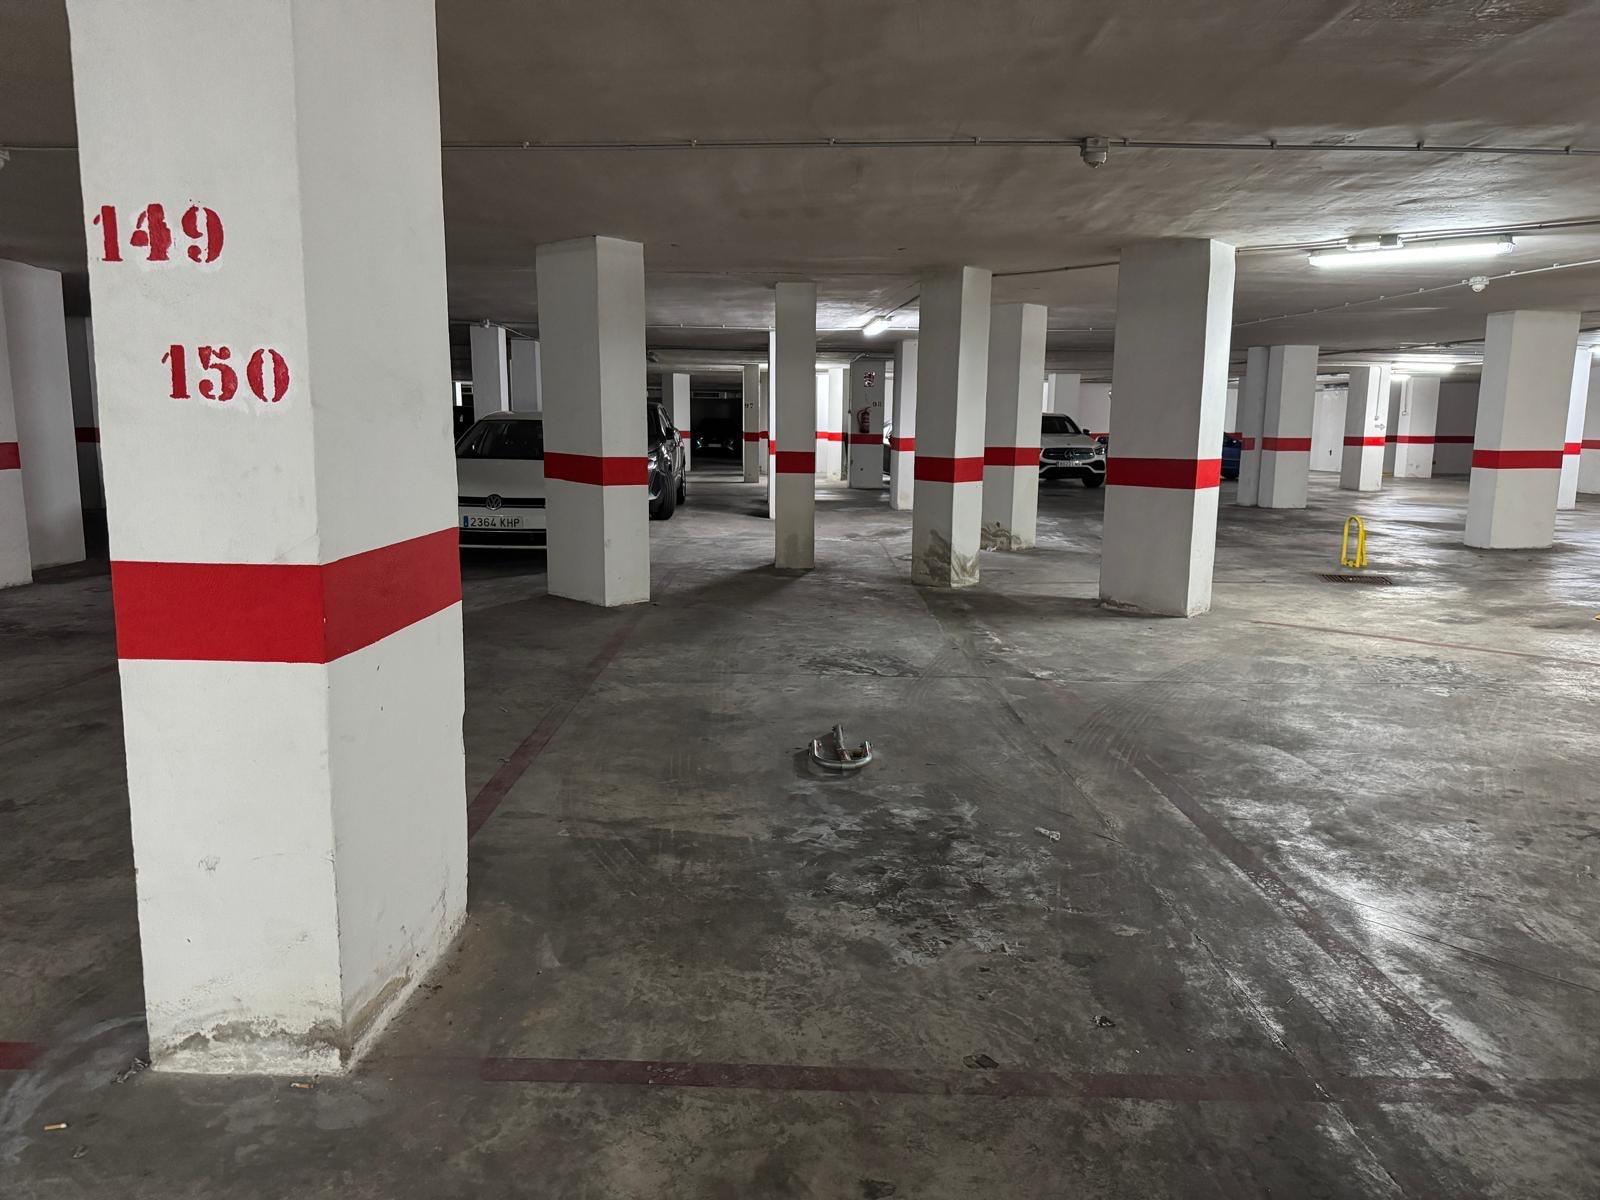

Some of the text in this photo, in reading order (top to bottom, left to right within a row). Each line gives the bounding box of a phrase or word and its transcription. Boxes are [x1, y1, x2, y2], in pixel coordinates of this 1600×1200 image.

[93, 203, 225, 263] 149
[161, 344, 291, 403] 150
[487, 495, 501, 509] VW
[470, 517, 520, 528] 2364 KHP
